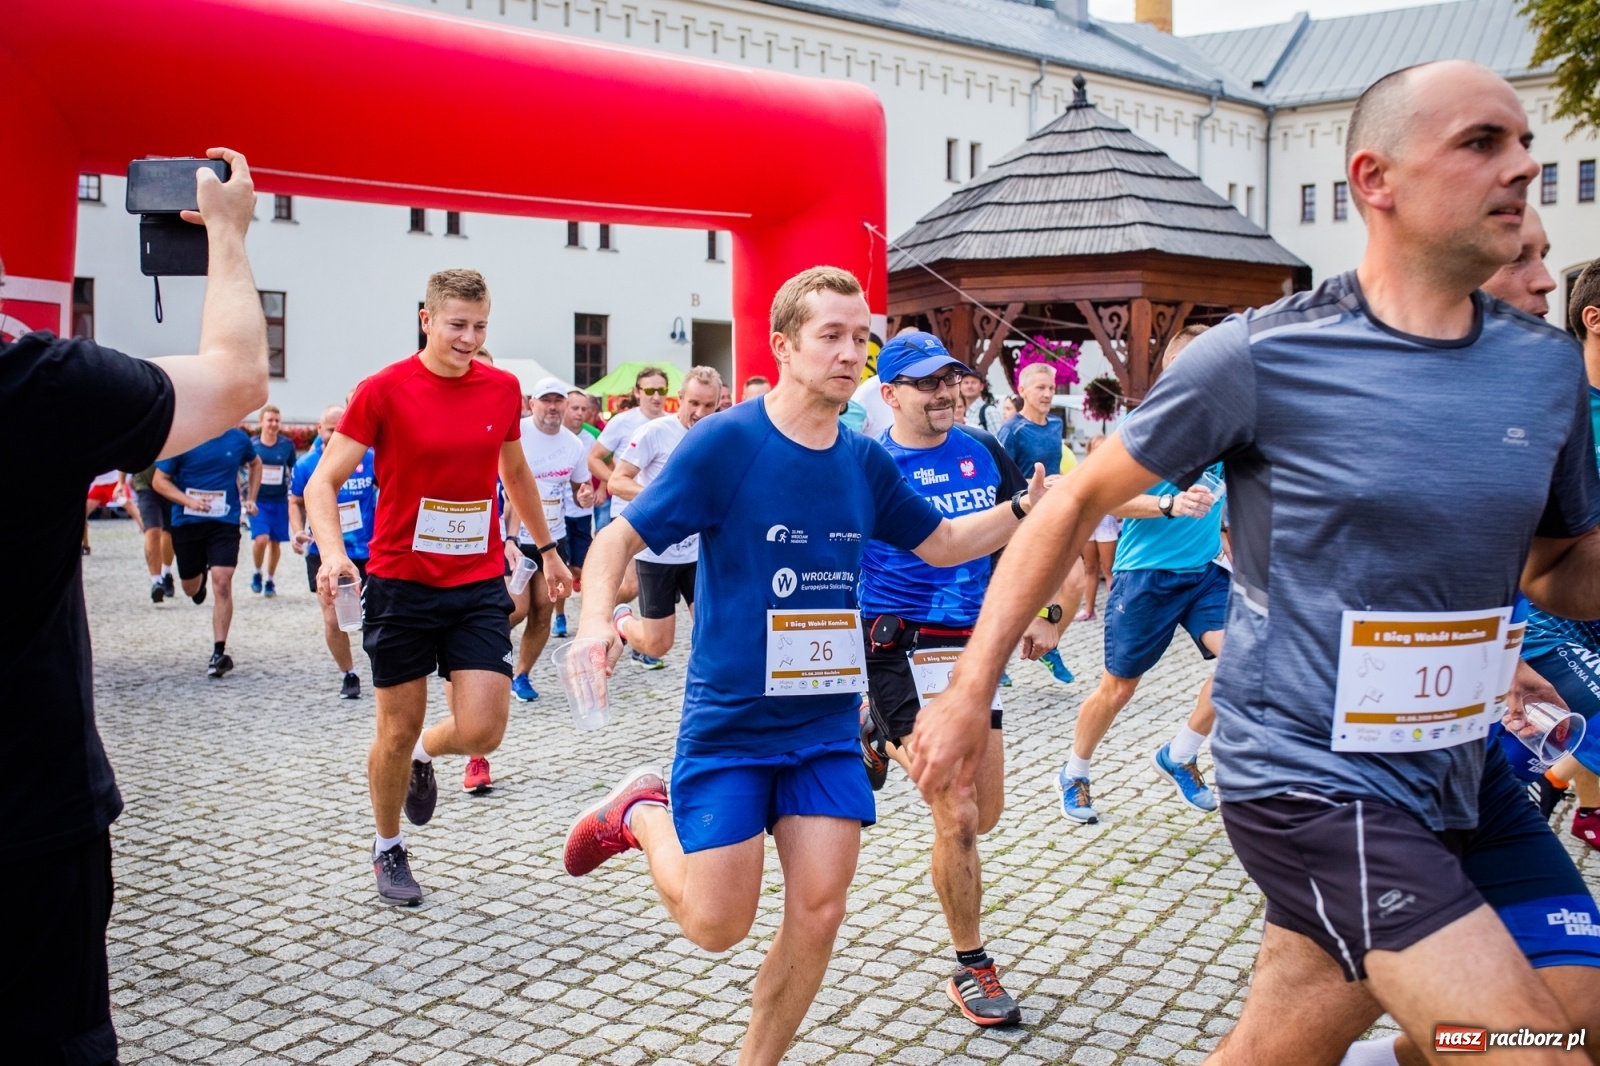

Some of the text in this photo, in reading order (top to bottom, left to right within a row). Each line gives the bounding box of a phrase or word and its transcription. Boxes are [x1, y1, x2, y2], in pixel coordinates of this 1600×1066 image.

[691, 293, 700, 307] B
[925, 485, 997, 513] NERS
[446, 520, 466, 534] 56
[801, 571, 842, 582] WROCŁAW
[790, 620, 806, 629] Bieg
[808, 619, 827, 627] Wokół
[828, 619, 848, 627] Komina
[1383, 630, 1411, 645] Bieg
[810, 640, 833, 662] 26
[1414, 665, 1453, 699] 10
[1587, 680, 1600, 701] TEA
[1547, 908, 1592, 925] eko
[1564, 923, 1600, 937] okn
